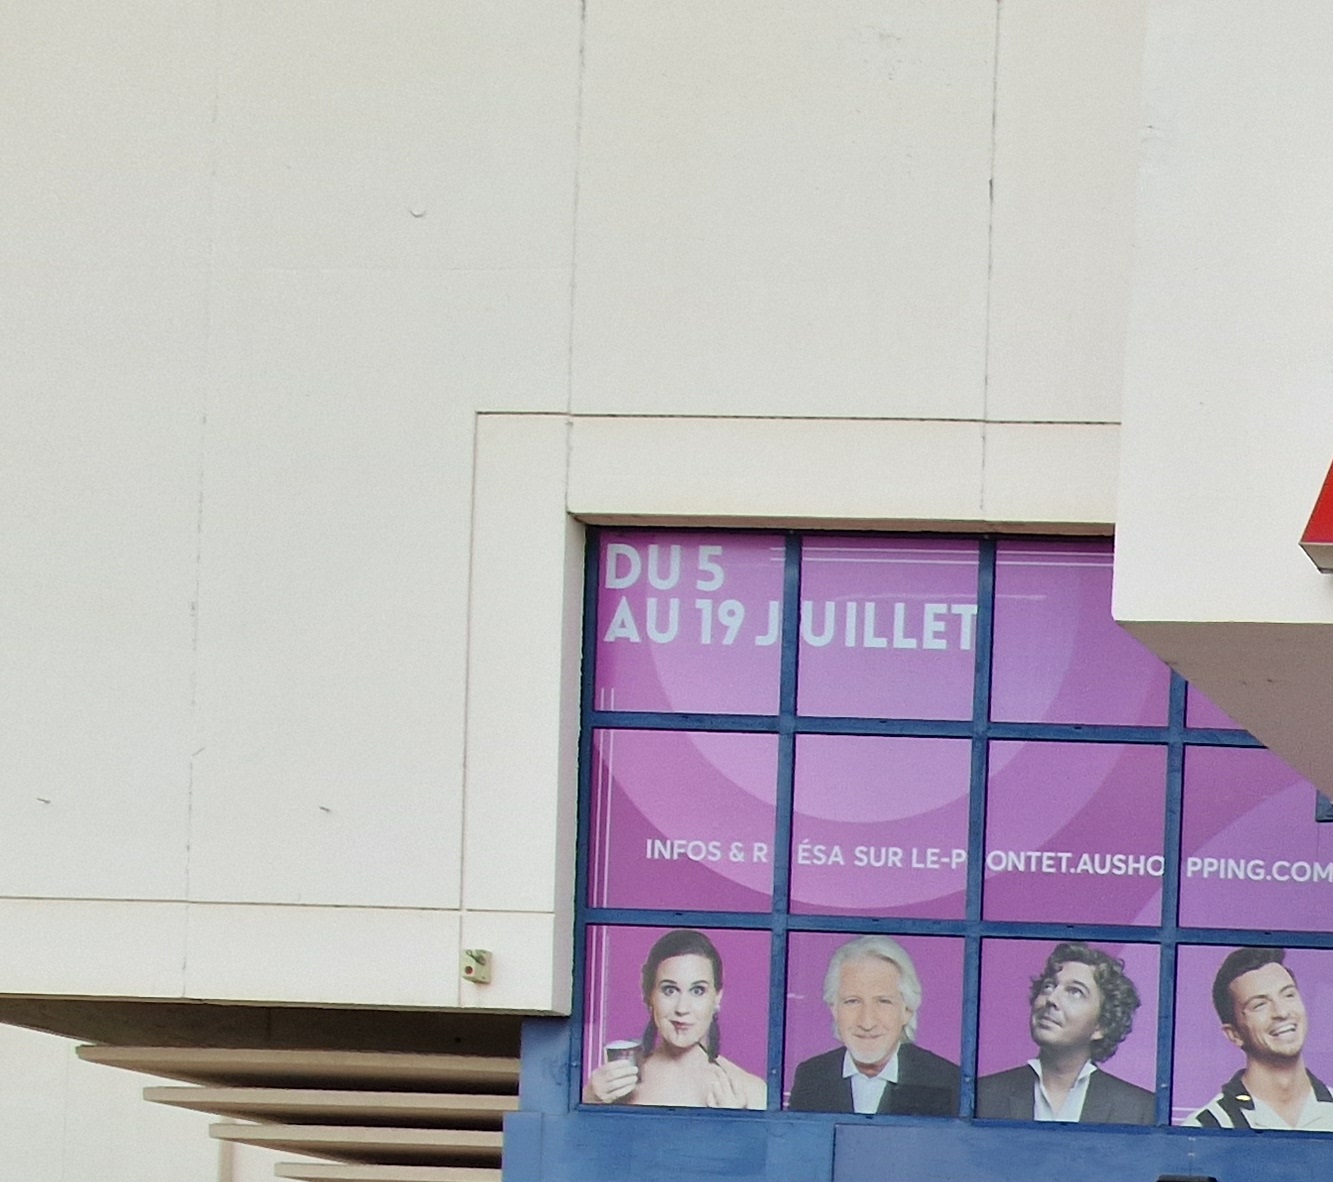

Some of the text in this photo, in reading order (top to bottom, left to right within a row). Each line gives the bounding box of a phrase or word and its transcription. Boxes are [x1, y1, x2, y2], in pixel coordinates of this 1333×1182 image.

[605, 543, 725, 591] DU 5
[603, 596, 978, 651] AU 19 JUILLET
[645, 839, 722, 862] INFOS
[728, 841, 746, 863] &
[853, 844, 903, 868] SUR
